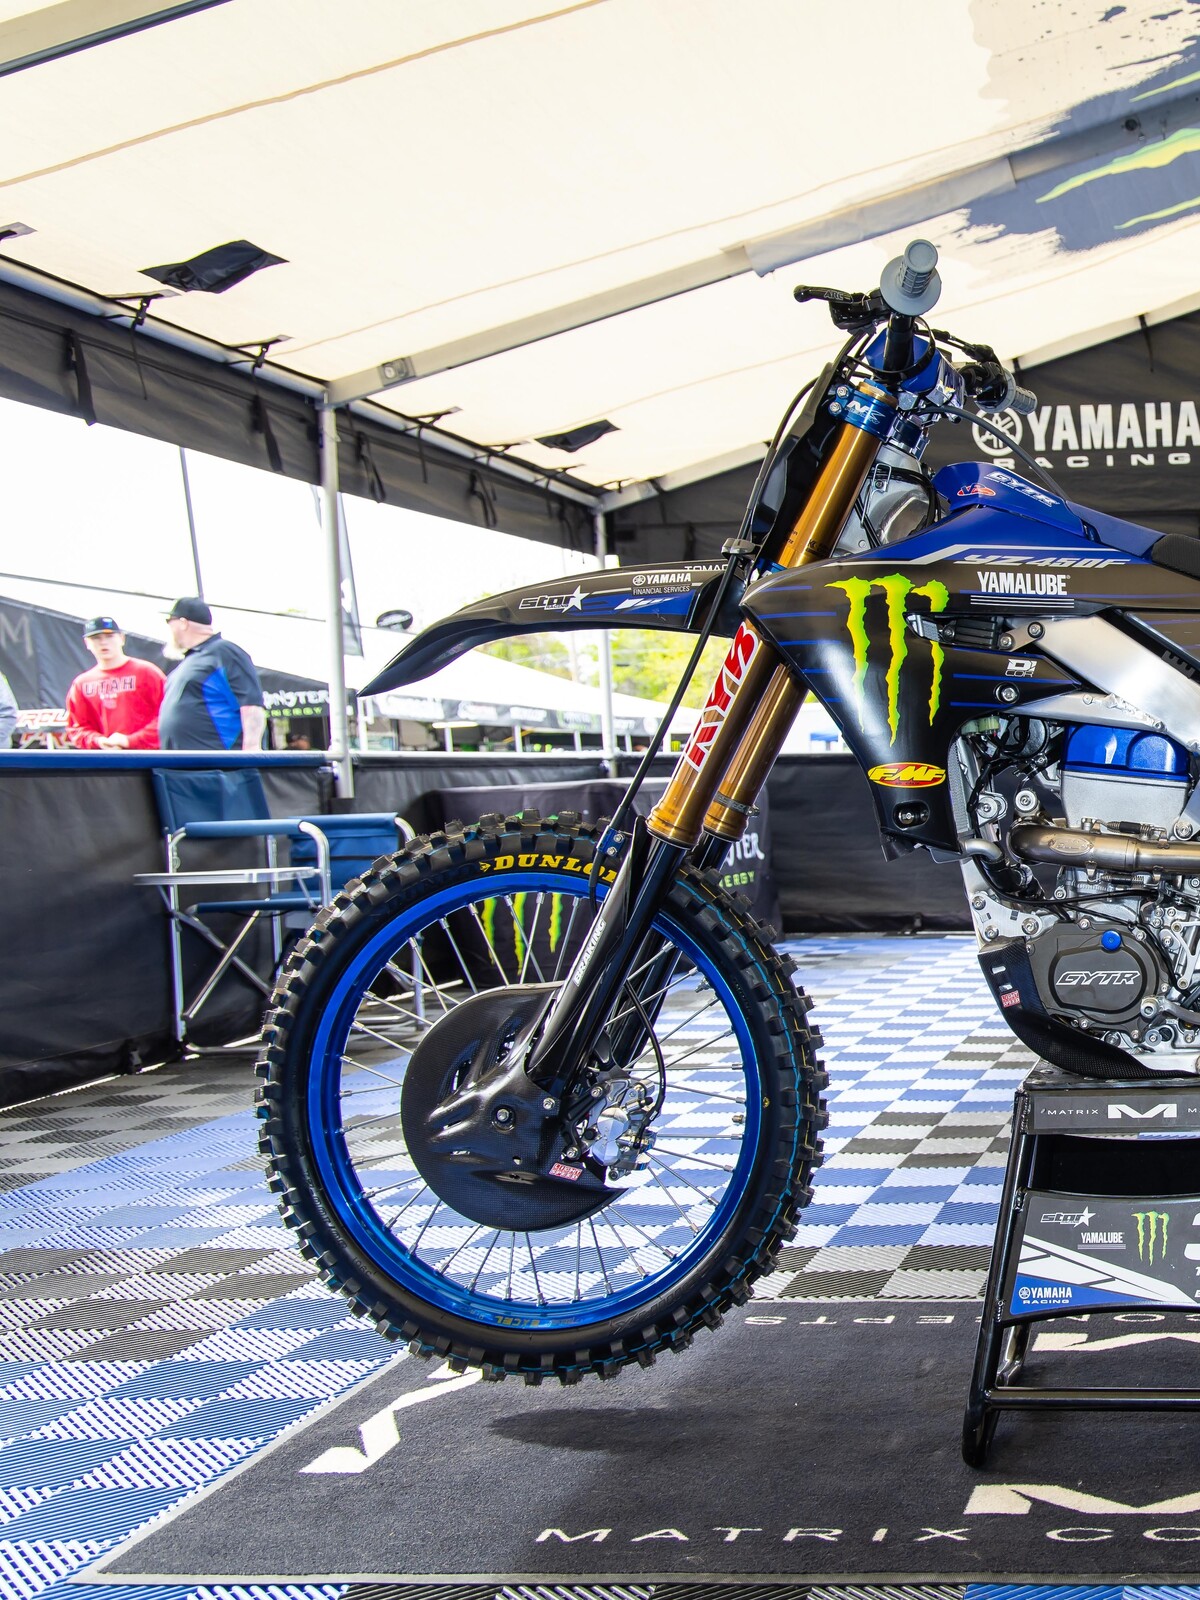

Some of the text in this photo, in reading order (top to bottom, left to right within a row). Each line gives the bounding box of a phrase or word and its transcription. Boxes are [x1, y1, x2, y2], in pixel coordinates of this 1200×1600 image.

[993, 452, 1191, 470] RACING
[646, 573, 692, 585] YAMAHA
[977, 571, 1068, 595] YAMALUBE
[633, 586, 690, 596] FINANCIAL SERVICES
[83, 676, 136, 697] UTAH
[686, 620, 760, 773] KYB
[869, 765, 946, 782] FMF
[1056, 971, 1140, 985] GYTR
[1081, 1232, 1124, 1244] YAMALUBE
[1030, 1287, 1072, 1298] YAMAHA
[495, 1314, 541, 1327] EXCEL
[534, 1526, 970, 1542] MATRIX
